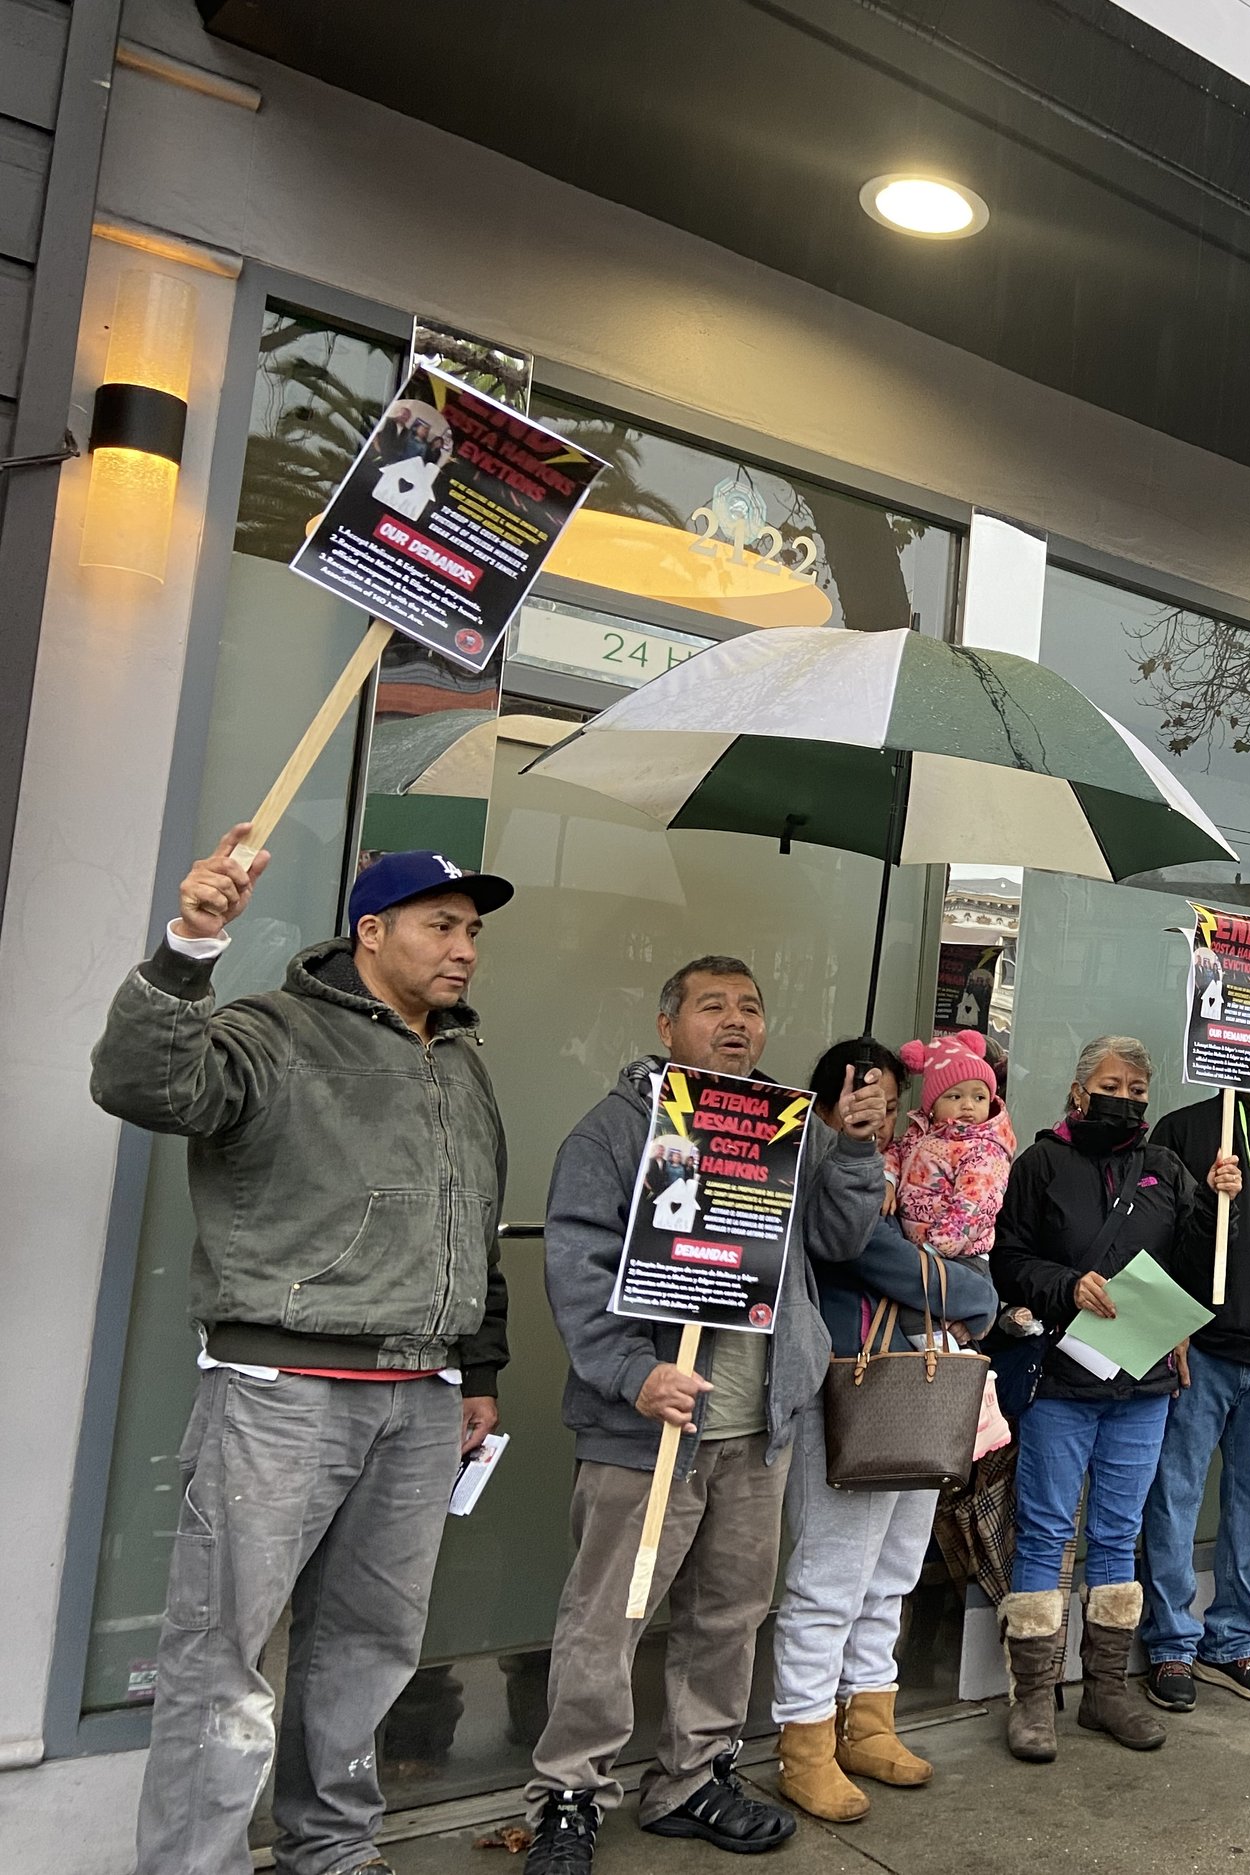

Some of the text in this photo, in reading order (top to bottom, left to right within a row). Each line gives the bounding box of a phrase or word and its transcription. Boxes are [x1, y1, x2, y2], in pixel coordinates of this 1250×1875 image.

[456, 438, 550, 503] EVICTIONS
[378, 521, 477, 584] OUR DEMANDS:
[689, 507, 818, 584] 2122
[394, 557, 404, 566] &
[393, 581, 402, 590] &
[401, 573, 410, 582] &
[362, 588, 373, 597] of
[363, 576, 372, 585] &
[407, 601, 421, 612] the
[602, 633, 648, 668] 24
[1211, 942, 1236, 957] COSTA
[1209, 1028, 1221, 1039] OUR
[700, 1089, 769, 1117] DETENGA
[693, 1111, 777, 1142] DESALOJOS
[710, 1136, 760, 1160] COSTA
[701, 1157, 768, 1182] HAWKINS
